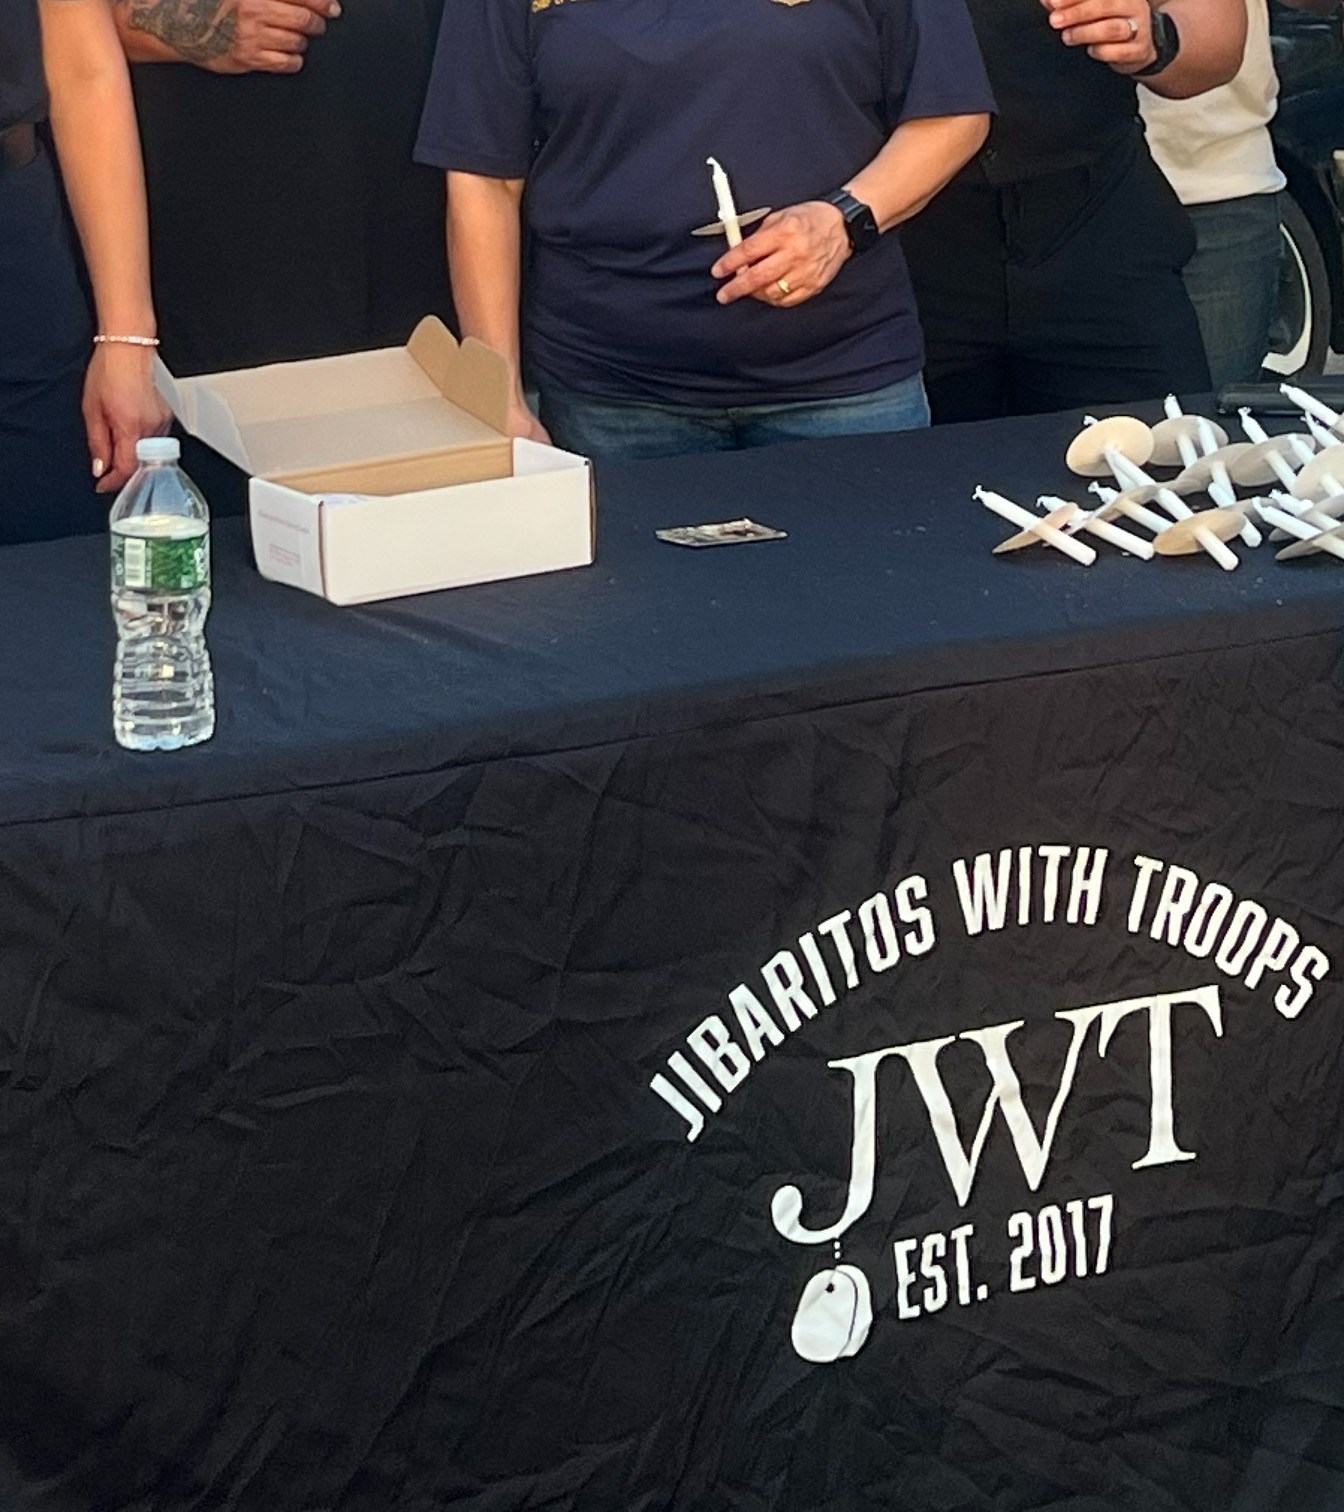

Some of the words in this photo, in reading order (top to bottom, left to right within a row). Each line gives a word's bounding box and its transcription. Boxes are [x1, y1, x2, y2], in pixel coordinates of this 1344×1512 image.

[650, 876, 936, 1143] JIBARITOS
[953, 845, 1109, 936] WITH
[1127, 855, 1330, 1019] TROOPS
[770, 984, 1224, 1244] JWT
[894, 1224, 988, 1320] EST.
[1008, 1195, 1113, 1292] 2017
